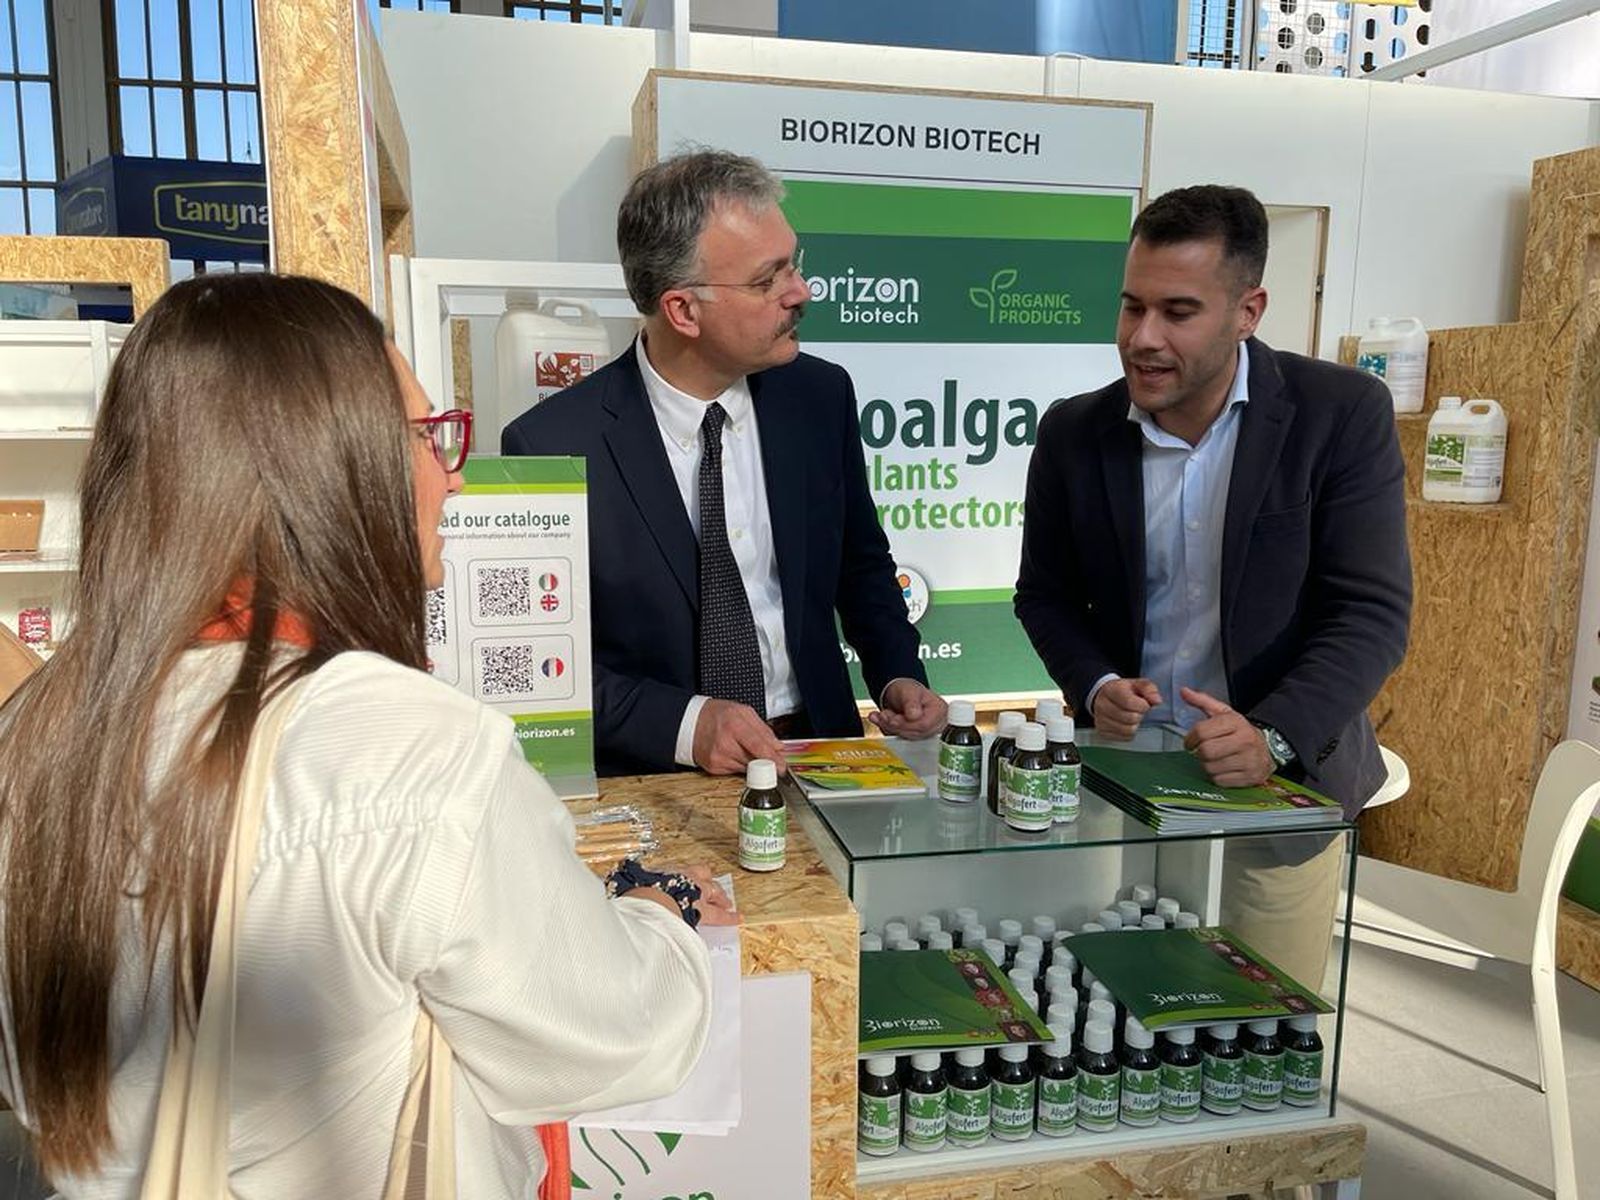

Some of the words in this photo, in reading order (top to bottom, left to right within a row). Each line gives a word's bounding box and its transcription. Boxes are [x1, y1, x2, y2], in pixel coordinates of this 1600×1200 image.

[780, 117, 916, 148] BIORIZON
[924, 126, 1041, 155] BIOTECH
[999, 293, 1071, 309] ORGANIC
[839, 303, 919, 325] biotech
[998, 309, 1082, 326] PRODUCTS
[867, 454, 958, 492] lants
[464, 514, 490, 528] our
[494, 510, 571, 531] catalogue
[514, 727, 576, 739] iorizon.es
